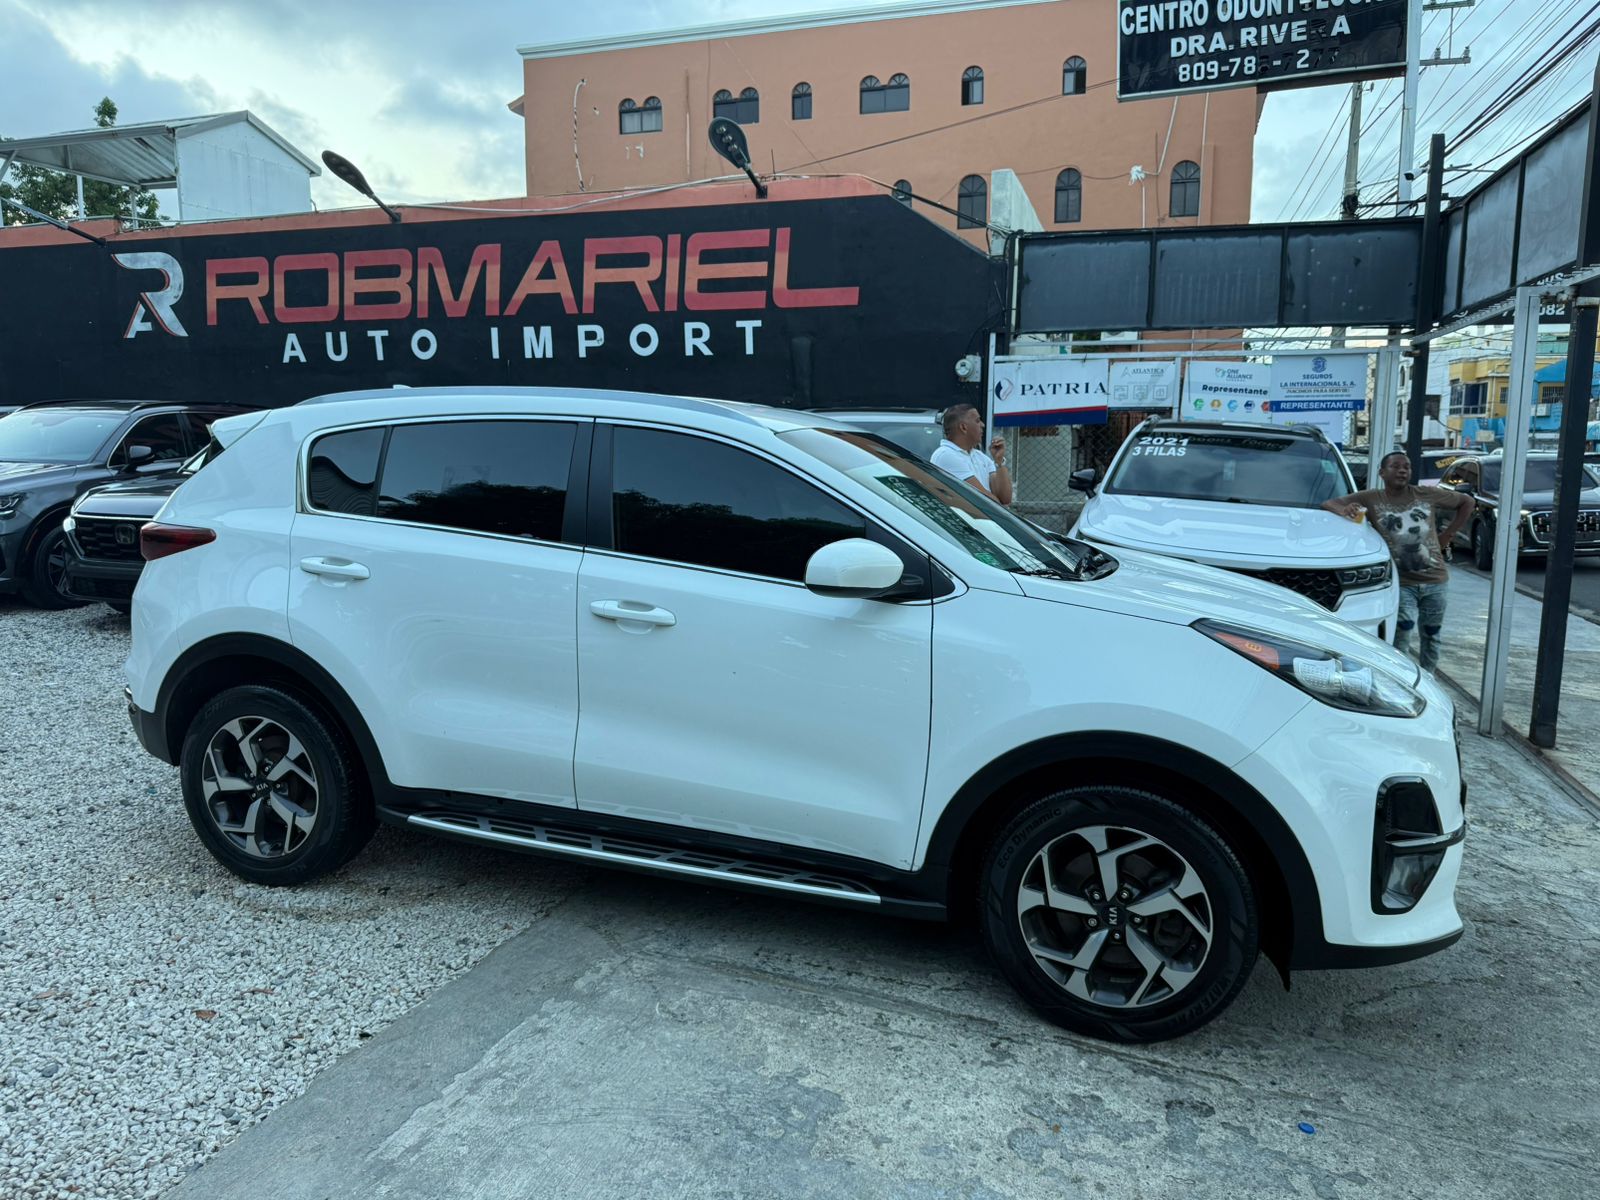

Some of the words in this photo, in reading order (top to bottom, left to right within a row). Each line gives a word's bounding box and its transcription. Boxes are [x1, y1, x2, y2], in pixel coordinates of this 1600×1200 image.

[1120, 2, 1209, 35] CENTRO
[1169, 32, 1235, 58] DRA.
[206, 227, 860, 326] ROBMARIEL
[282, 328, 438, 364] AUTO
[490, 319, 762, 359] IMPORT
[1020, 382, 1106, 396] PATRIA
[1201, 384, 1269, 396] Representante
[1280, 401, 1354, 410] REPRESENTANTE
[1138, 436, 1189, 446] 2021
[1132, 446, 1142, 456] 3
[1144, 446, 1187, 457] FILAS
[1109, 907, 1118, 925] KIA
